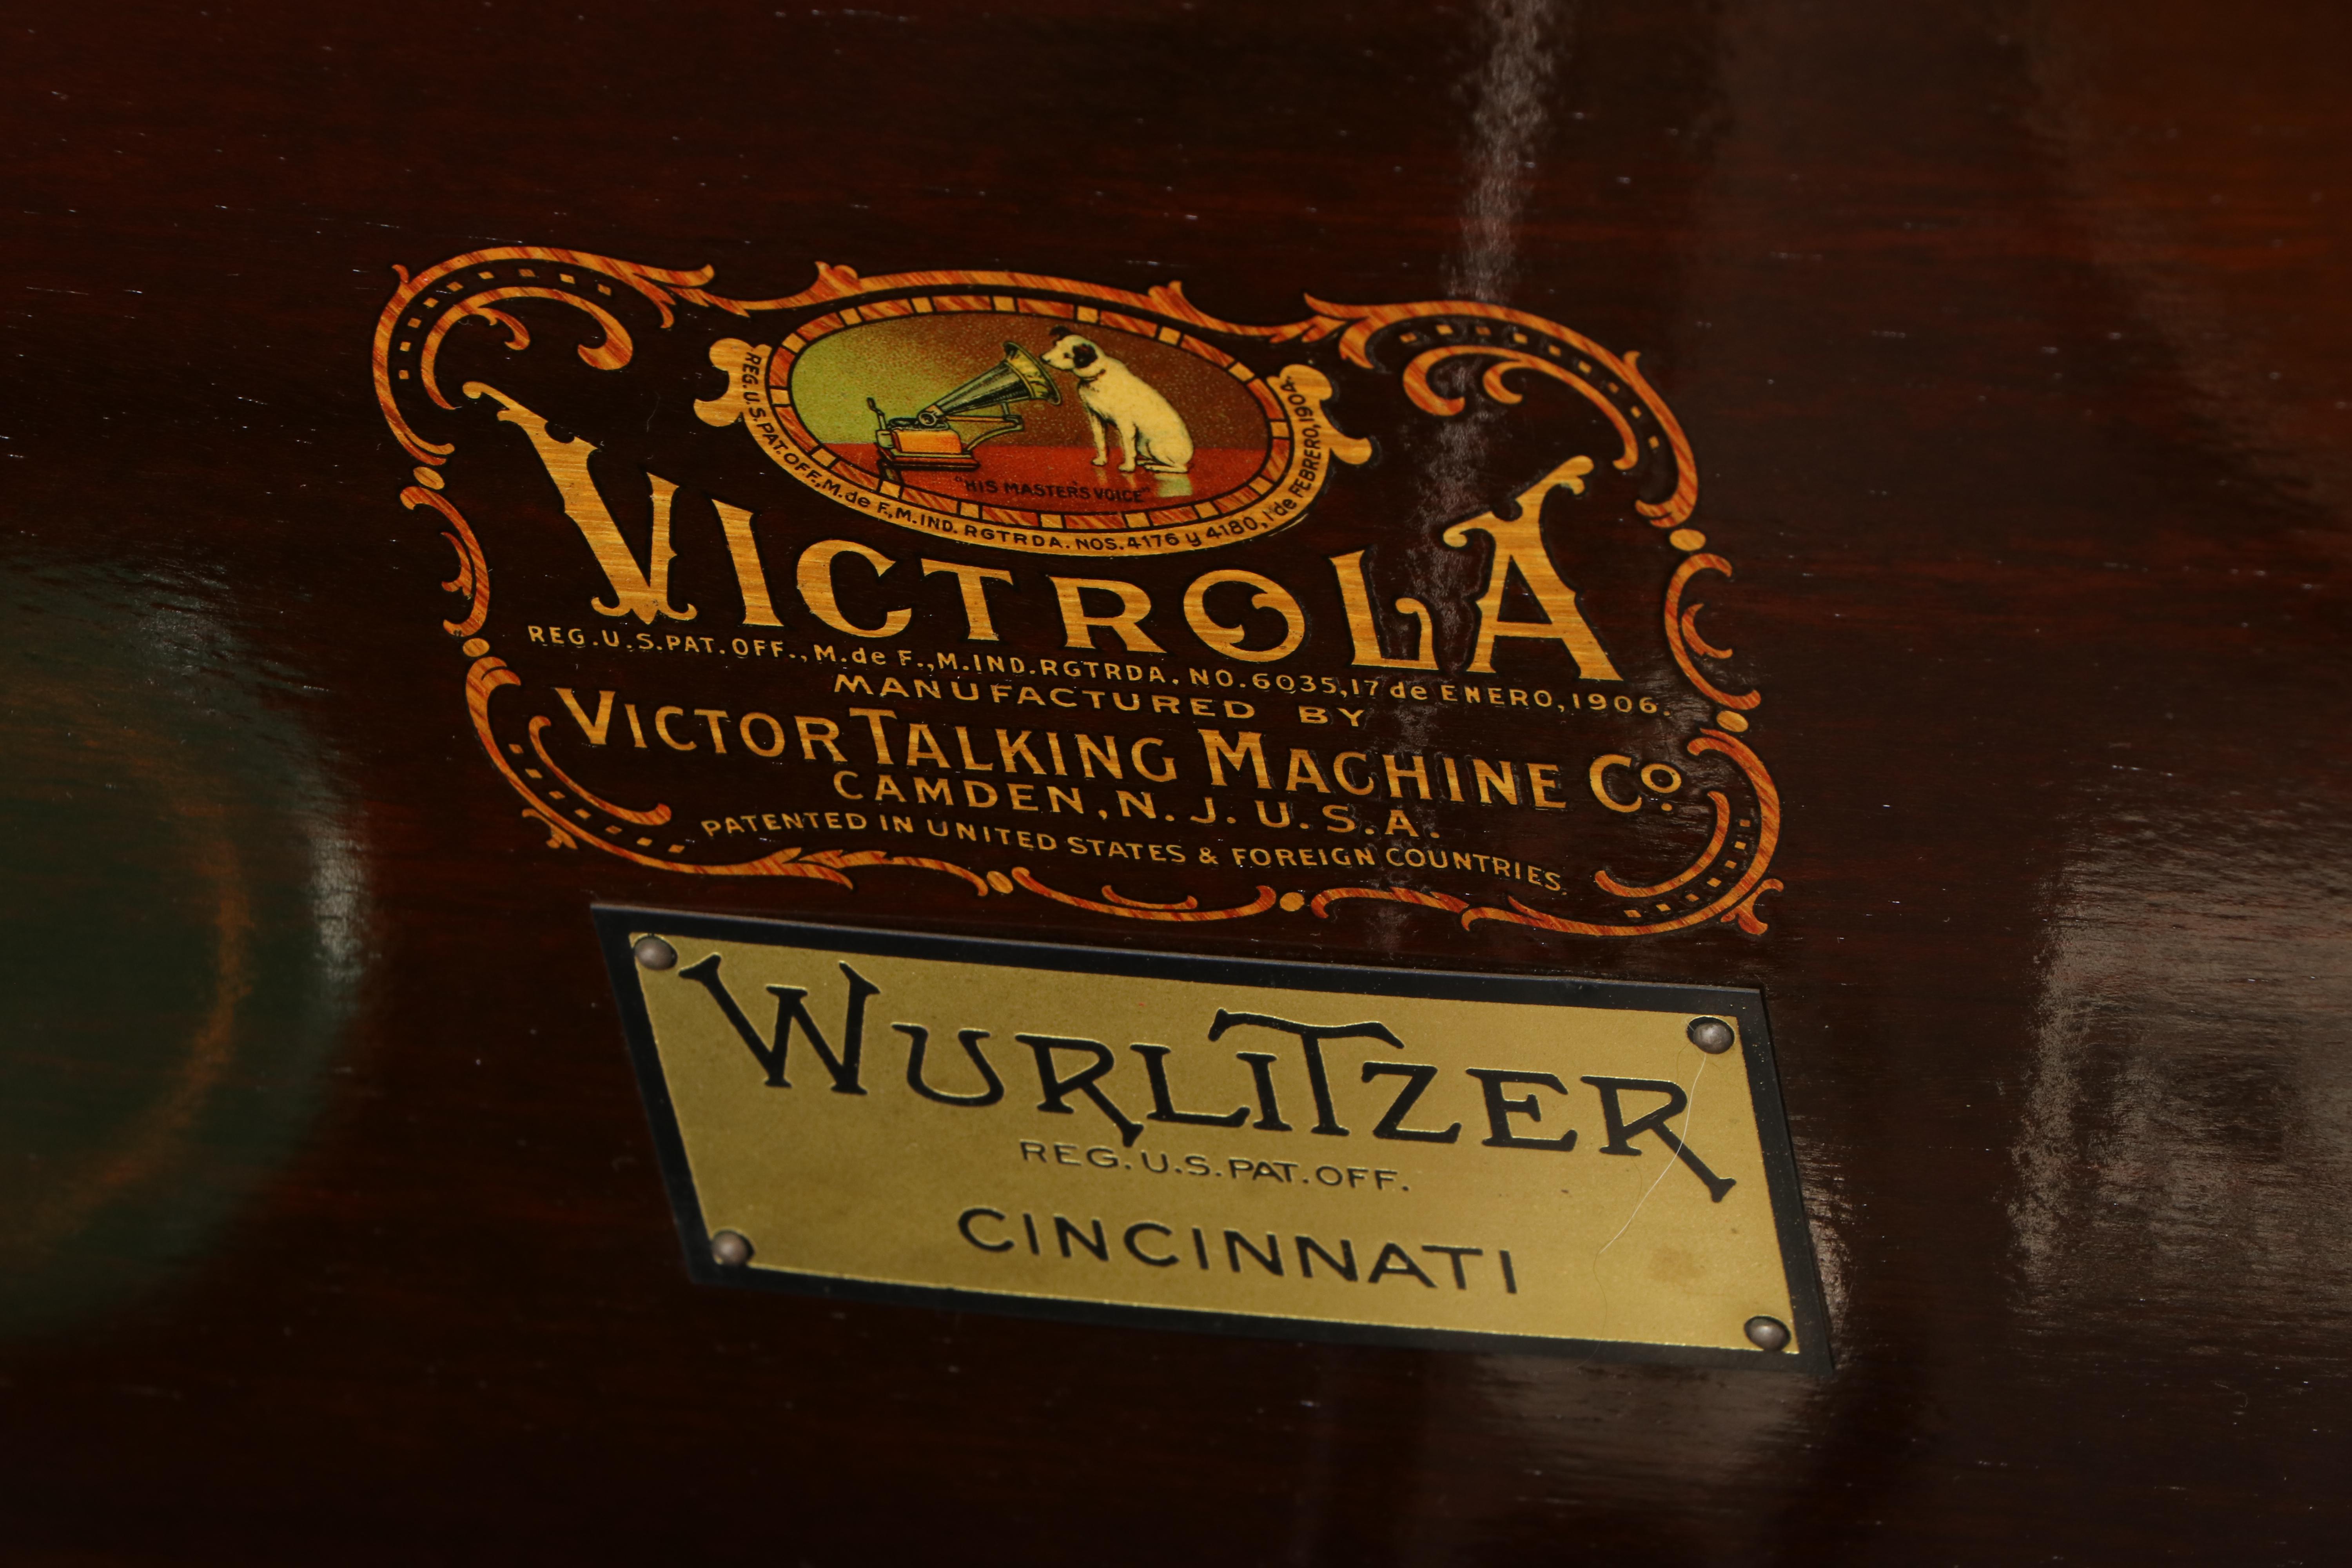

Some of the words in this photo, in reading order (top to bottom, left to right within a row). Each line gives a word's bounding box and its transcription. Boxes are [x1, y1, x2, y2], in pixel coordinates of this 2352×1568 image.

[462, 381, 1624, 681] VICTROLA
[834, 673, 1255, 719] MANUFACTURED
[1298, 706, 1365, 728] BY
[848, 707, 1177, 783] TALKING
[1197, 728, 1567, 810] MACHINE
[833, 770, 1108, 821] CAMDEN,
[701, 812, 867, 836] PATENTED
[878, 814, 913, 833] IN
[927, 819, 1057, 851] UNITED
[1067, 836, 1186, 864] STATES
[1198, 846, 1219, 865] &
[1231, 847, 1376, 867] FOREIGN
[677, 953, 1738, 1204] WURLITZER
[1020, 1140, 1132, 1170] REG.
[1229, 1158, 1309, 1183] PAT.
[1316, 1165, 1409, 1192] OFF.
[958, 1207, 1518, 1294] CINCINNATI
